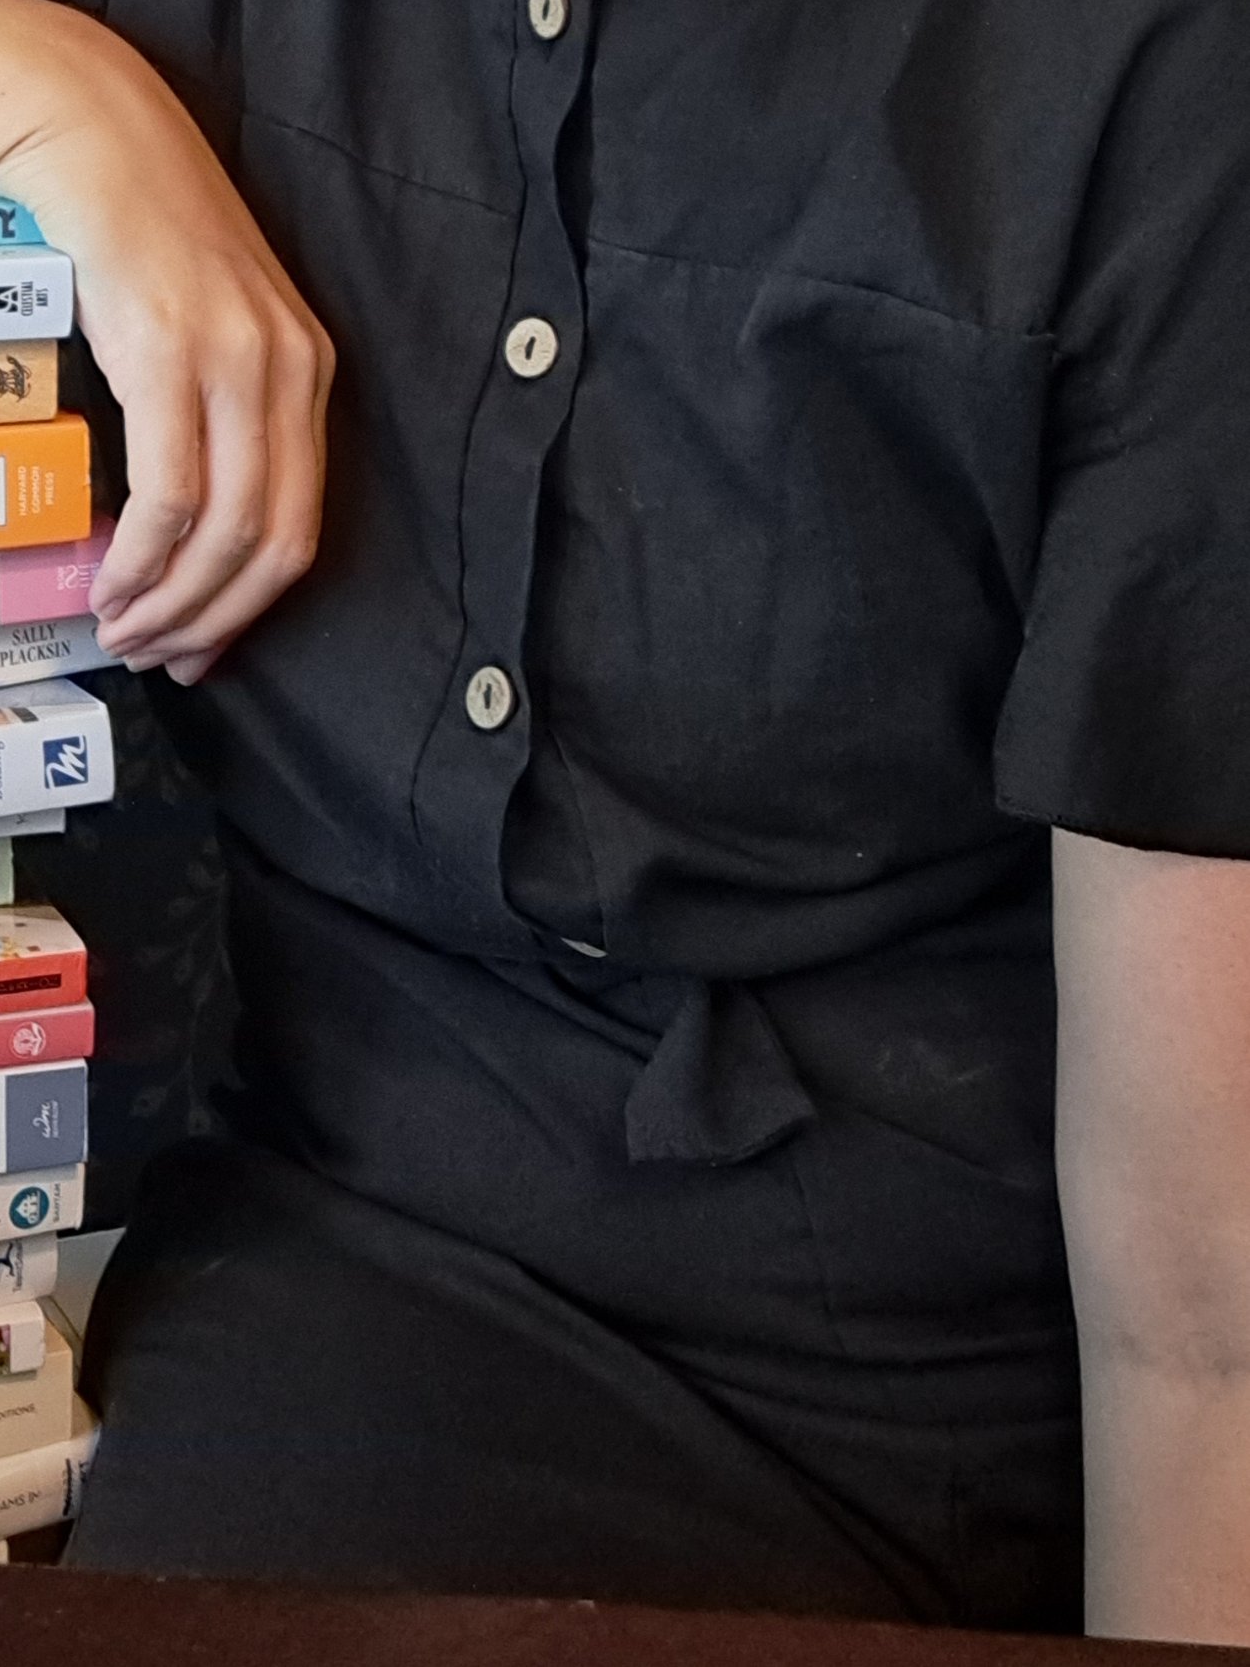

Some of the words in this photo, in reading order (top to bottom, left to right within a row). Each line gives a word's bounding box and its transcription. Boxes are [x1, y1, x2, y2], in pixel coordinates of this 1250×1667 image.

[21, 280, 34, 317] CELESTIAL
[35, 287, 49, 308] ARTS
[12, 623, 61, 647] SALLY
[0, 640, 72, 668] PLACKSIN
